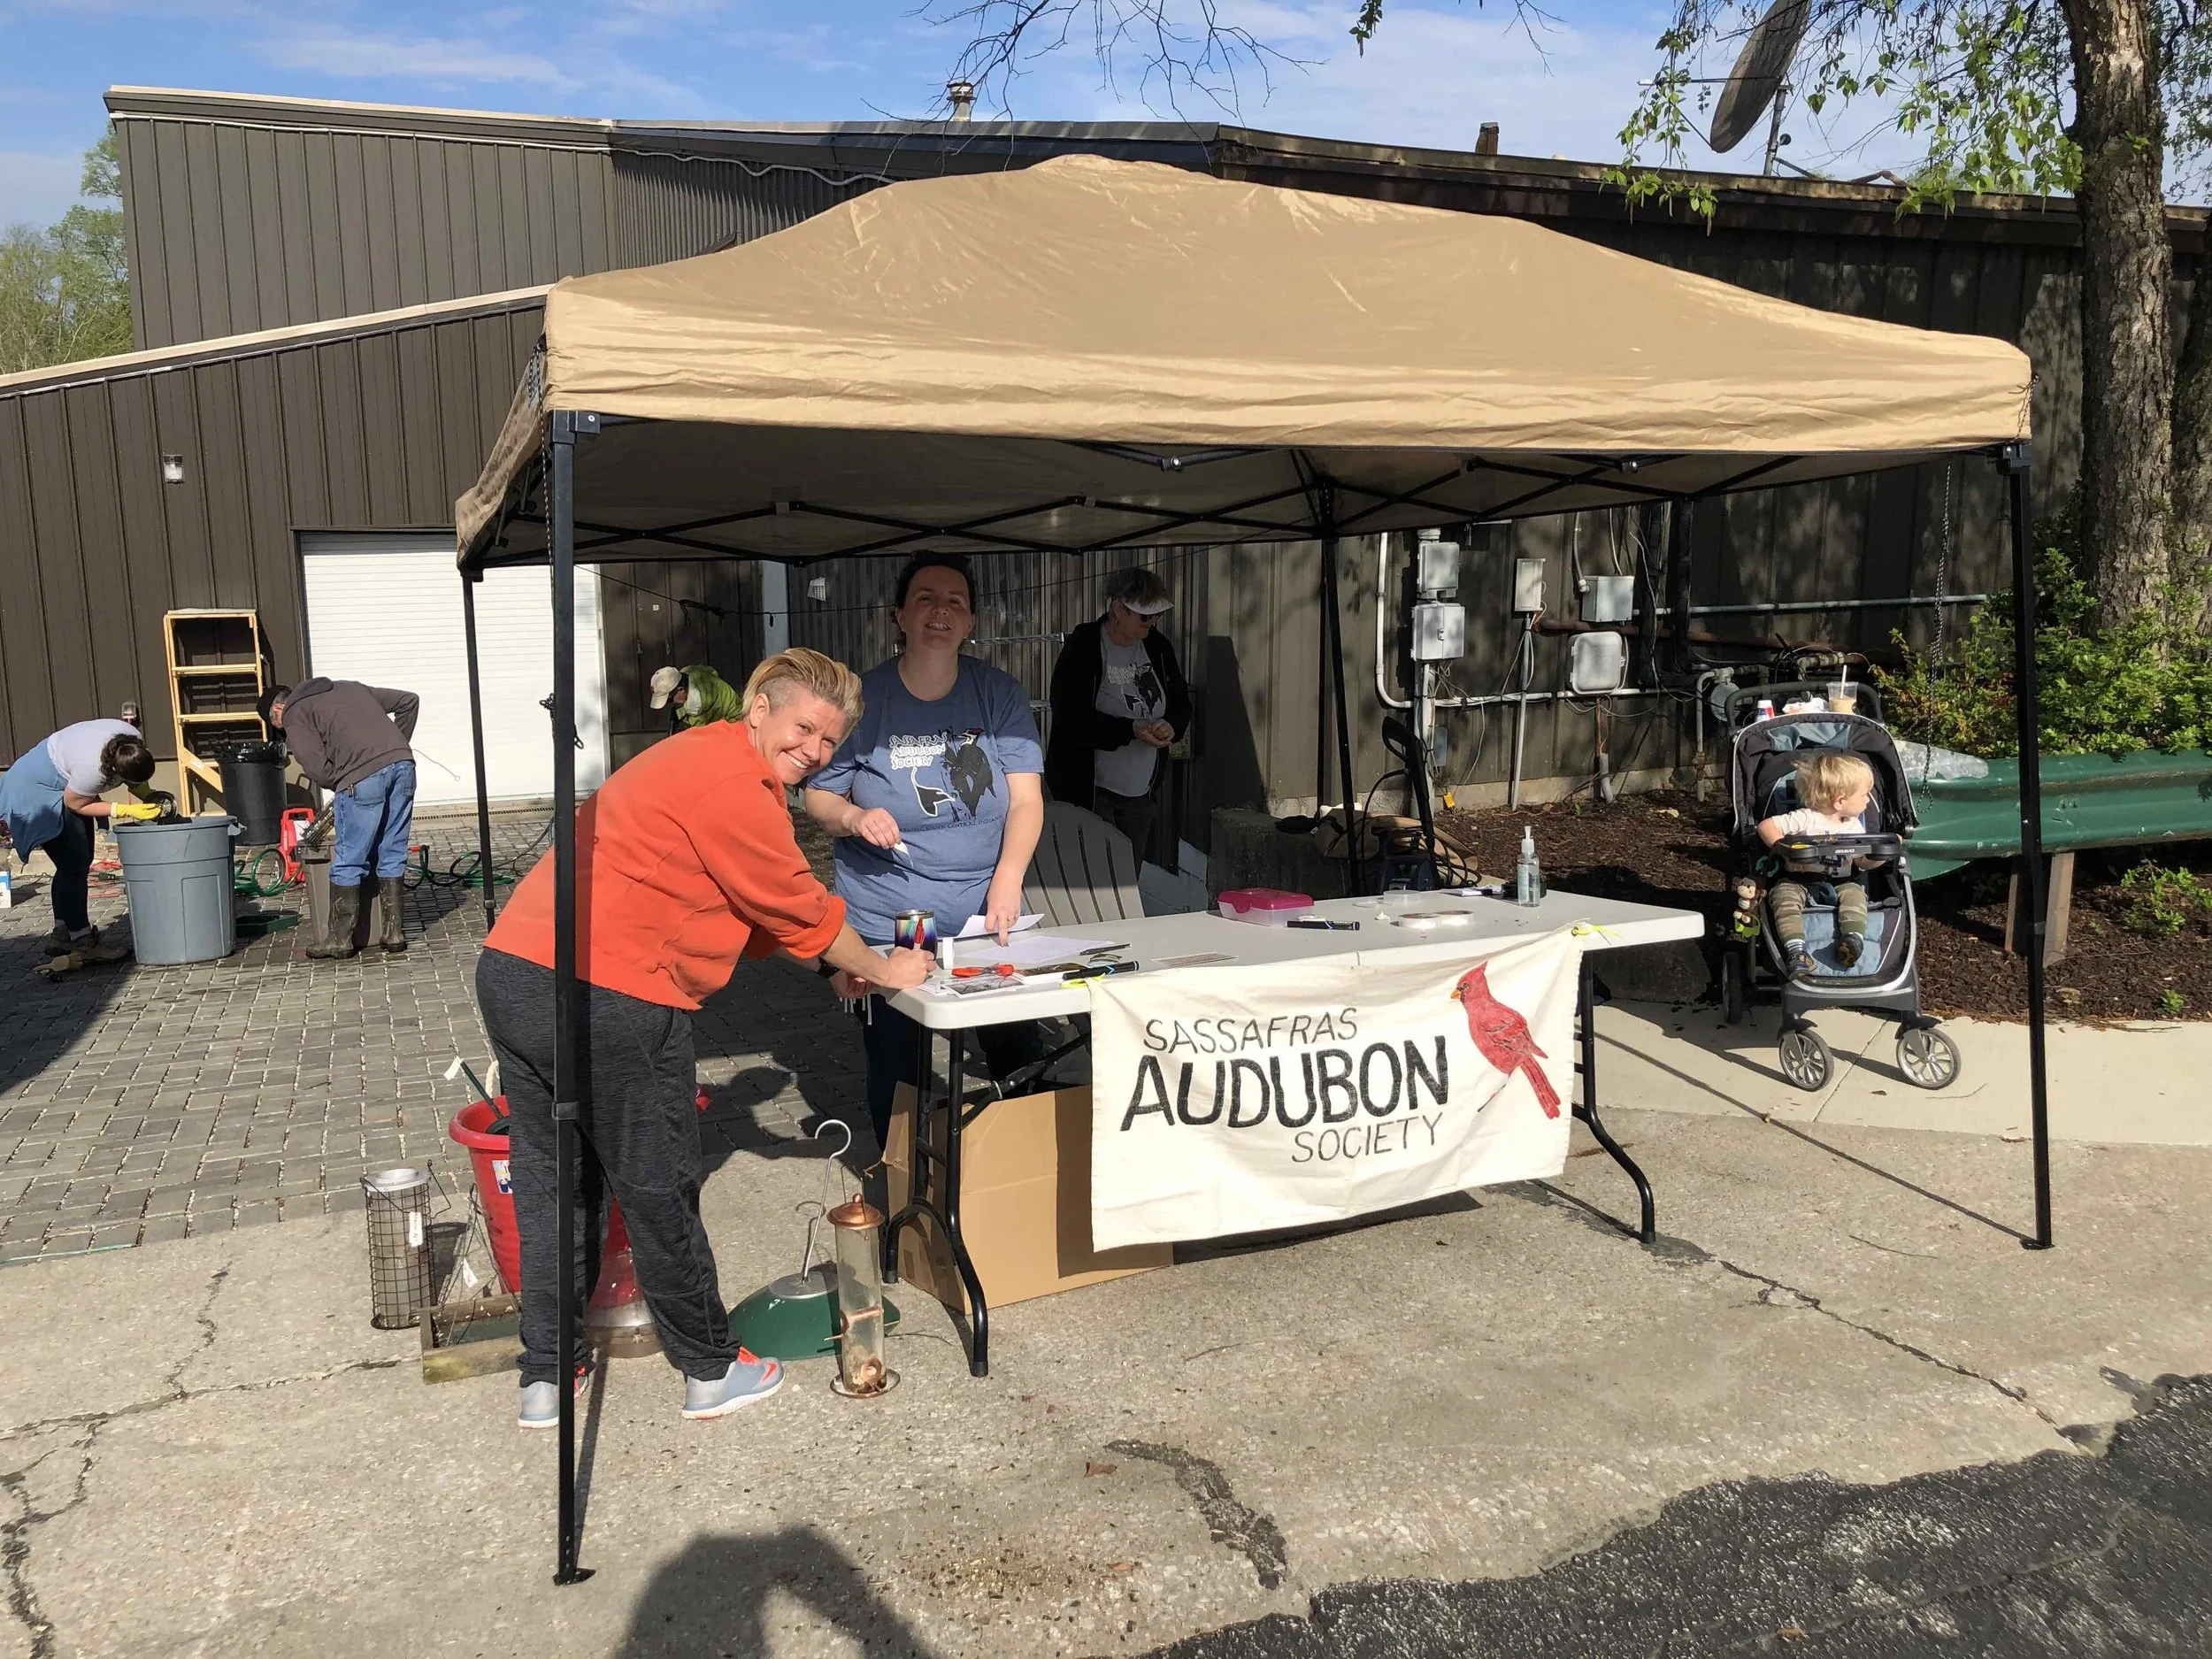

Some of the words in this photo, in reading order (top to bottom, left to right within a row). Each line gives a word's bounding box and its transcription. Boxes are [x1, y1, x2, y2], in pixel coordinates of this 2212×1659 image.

[889, 732, 948, 748] SASSAFRAS
[890, 743, 946, 758] AUDUBON
[891, 756, 933, 770] SOCIETY
[1142, 1007, 1358, 1055] SASSAFRAS
[1119, 1034, 1448, 1132] AUDUBON
[1291, 1111, 1443, 1163] SOCIETY
